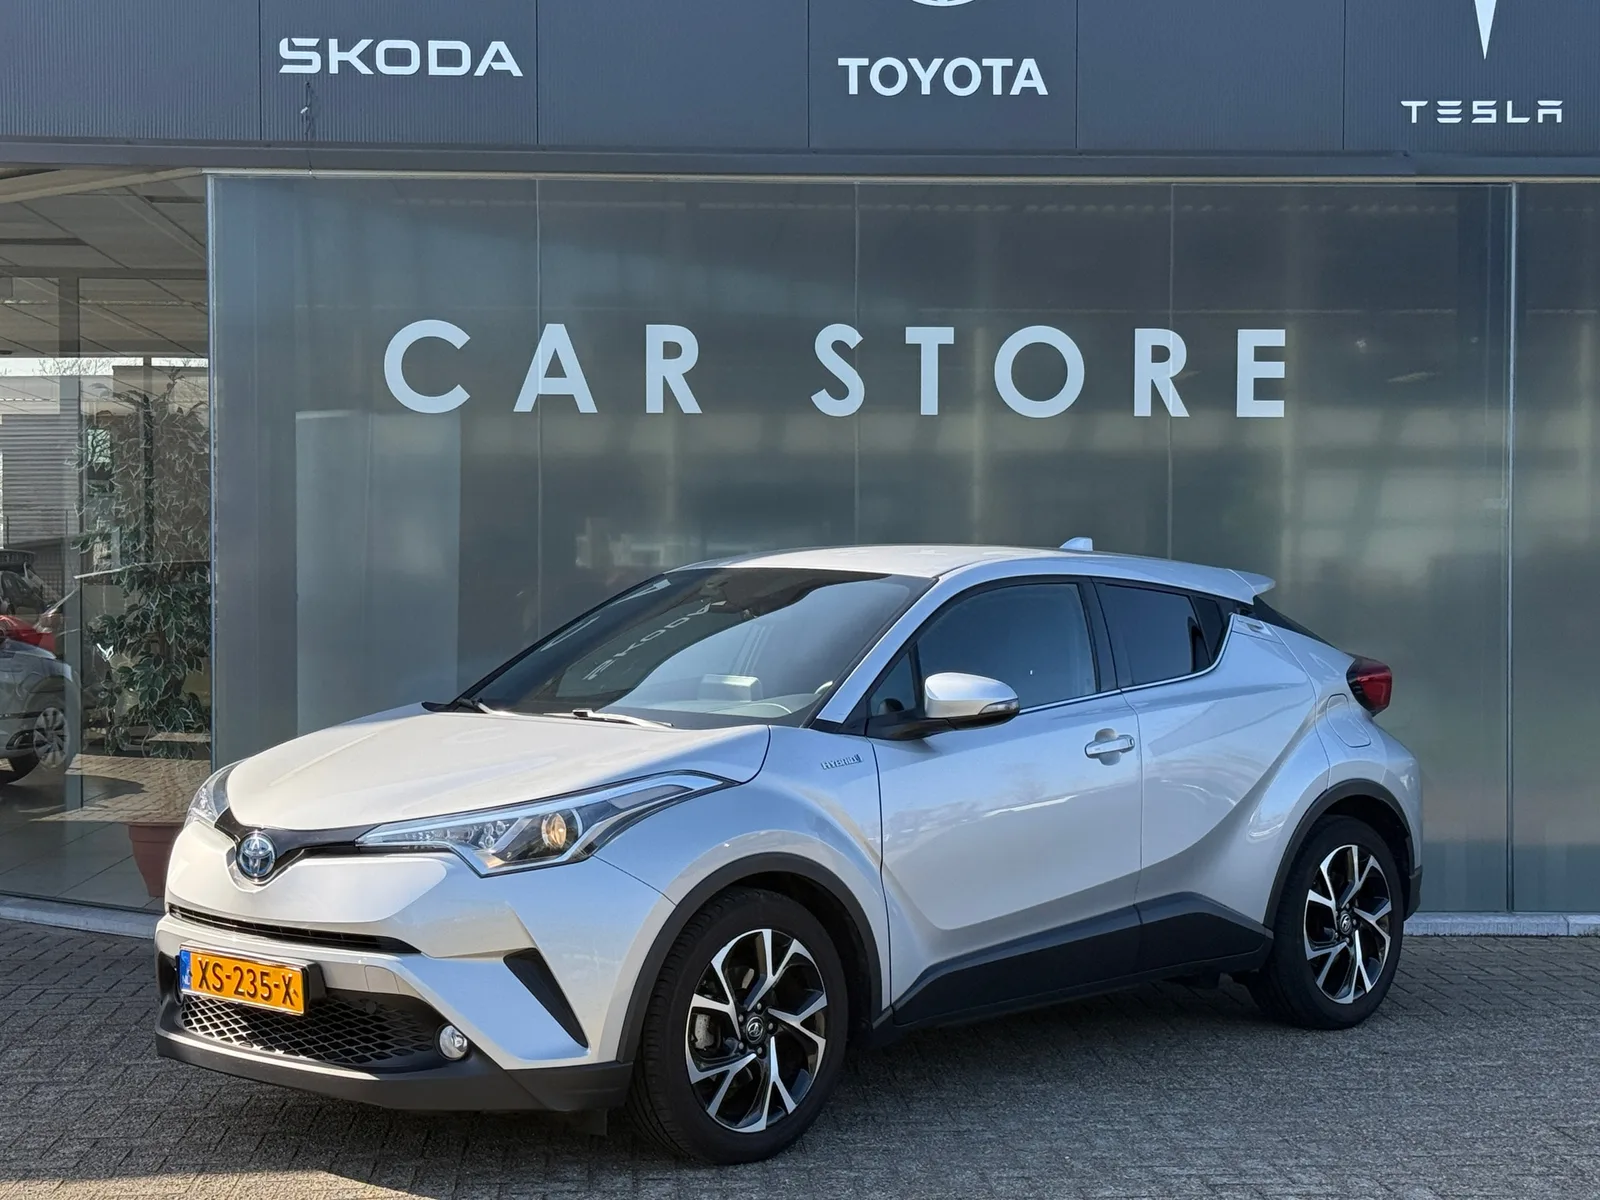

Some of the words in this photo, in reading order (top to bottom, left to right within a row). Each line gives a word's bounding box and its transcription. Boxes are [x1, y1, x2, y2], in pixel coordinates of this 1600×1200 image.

[838, 57, 1049, 97] TOYOTA
[1400, 99, 1563, 124] TESLA
[384, 319, 703, 415] CAR
[811, 322, 1286, 419] STORE
[198, 957, 295, 1006] XS-235-X
